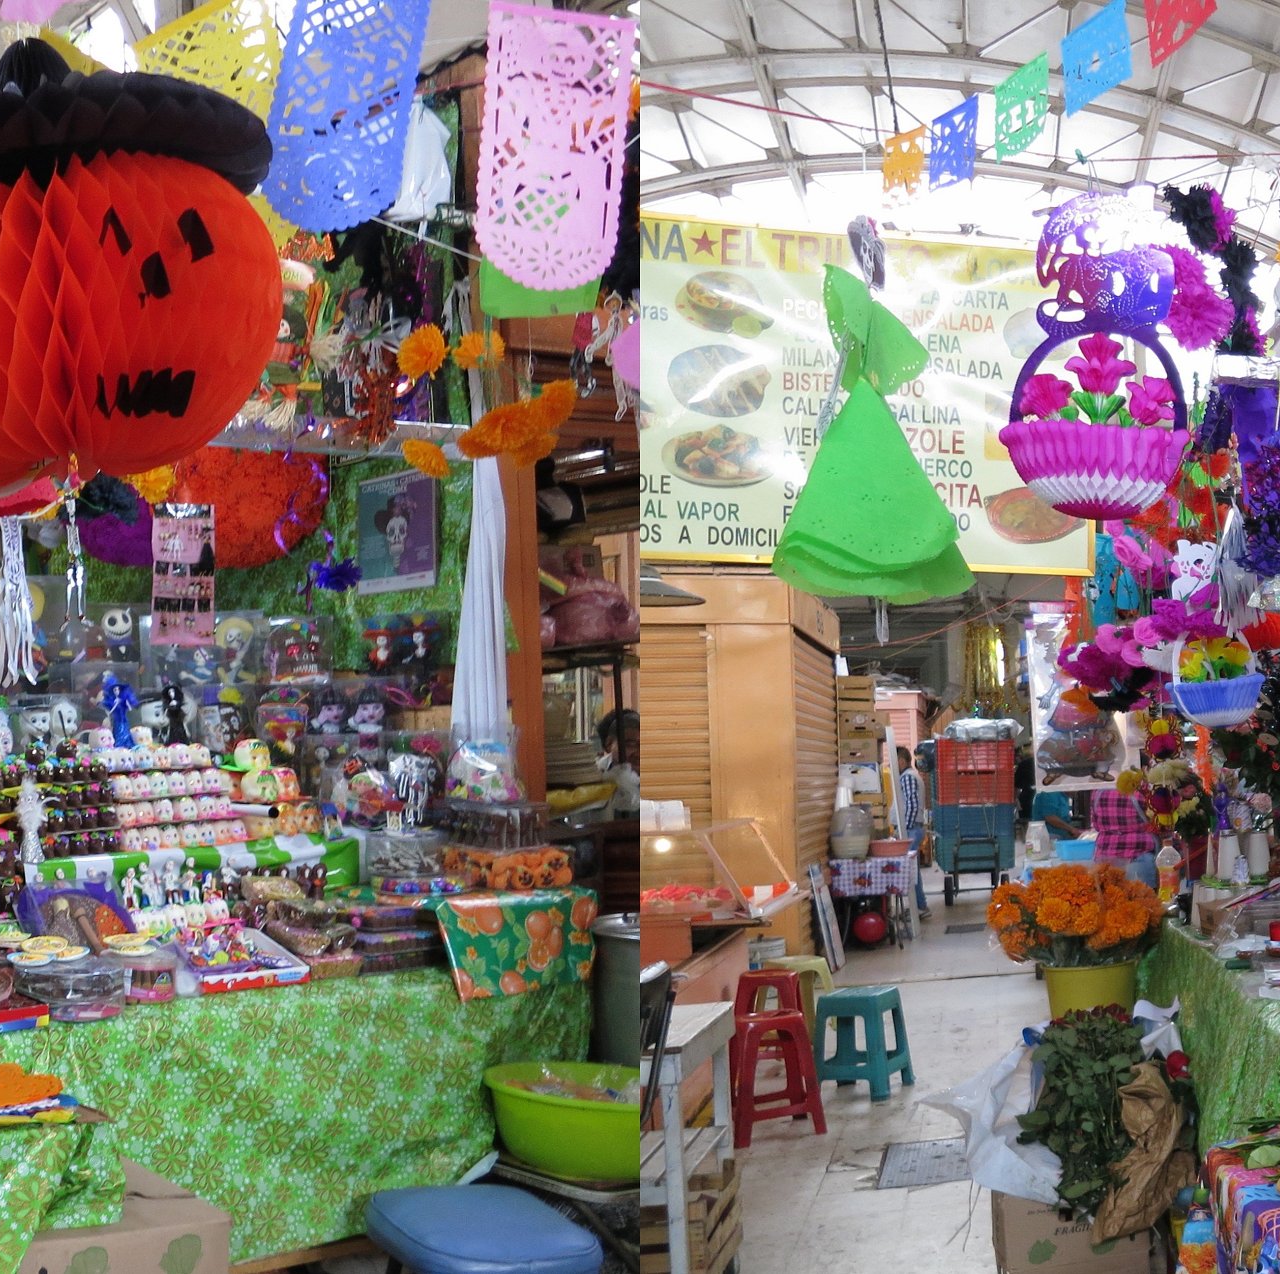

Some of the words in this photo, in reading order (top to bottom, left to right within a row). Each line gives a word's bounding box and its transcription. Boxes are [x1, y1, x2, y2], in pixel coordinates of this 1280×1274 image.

[721, 228, 765, 269] EL
[644, 499, 668, 519] AL
[677, 500, 740, 522] VAPOR
[678, 525, 691, 545] A
